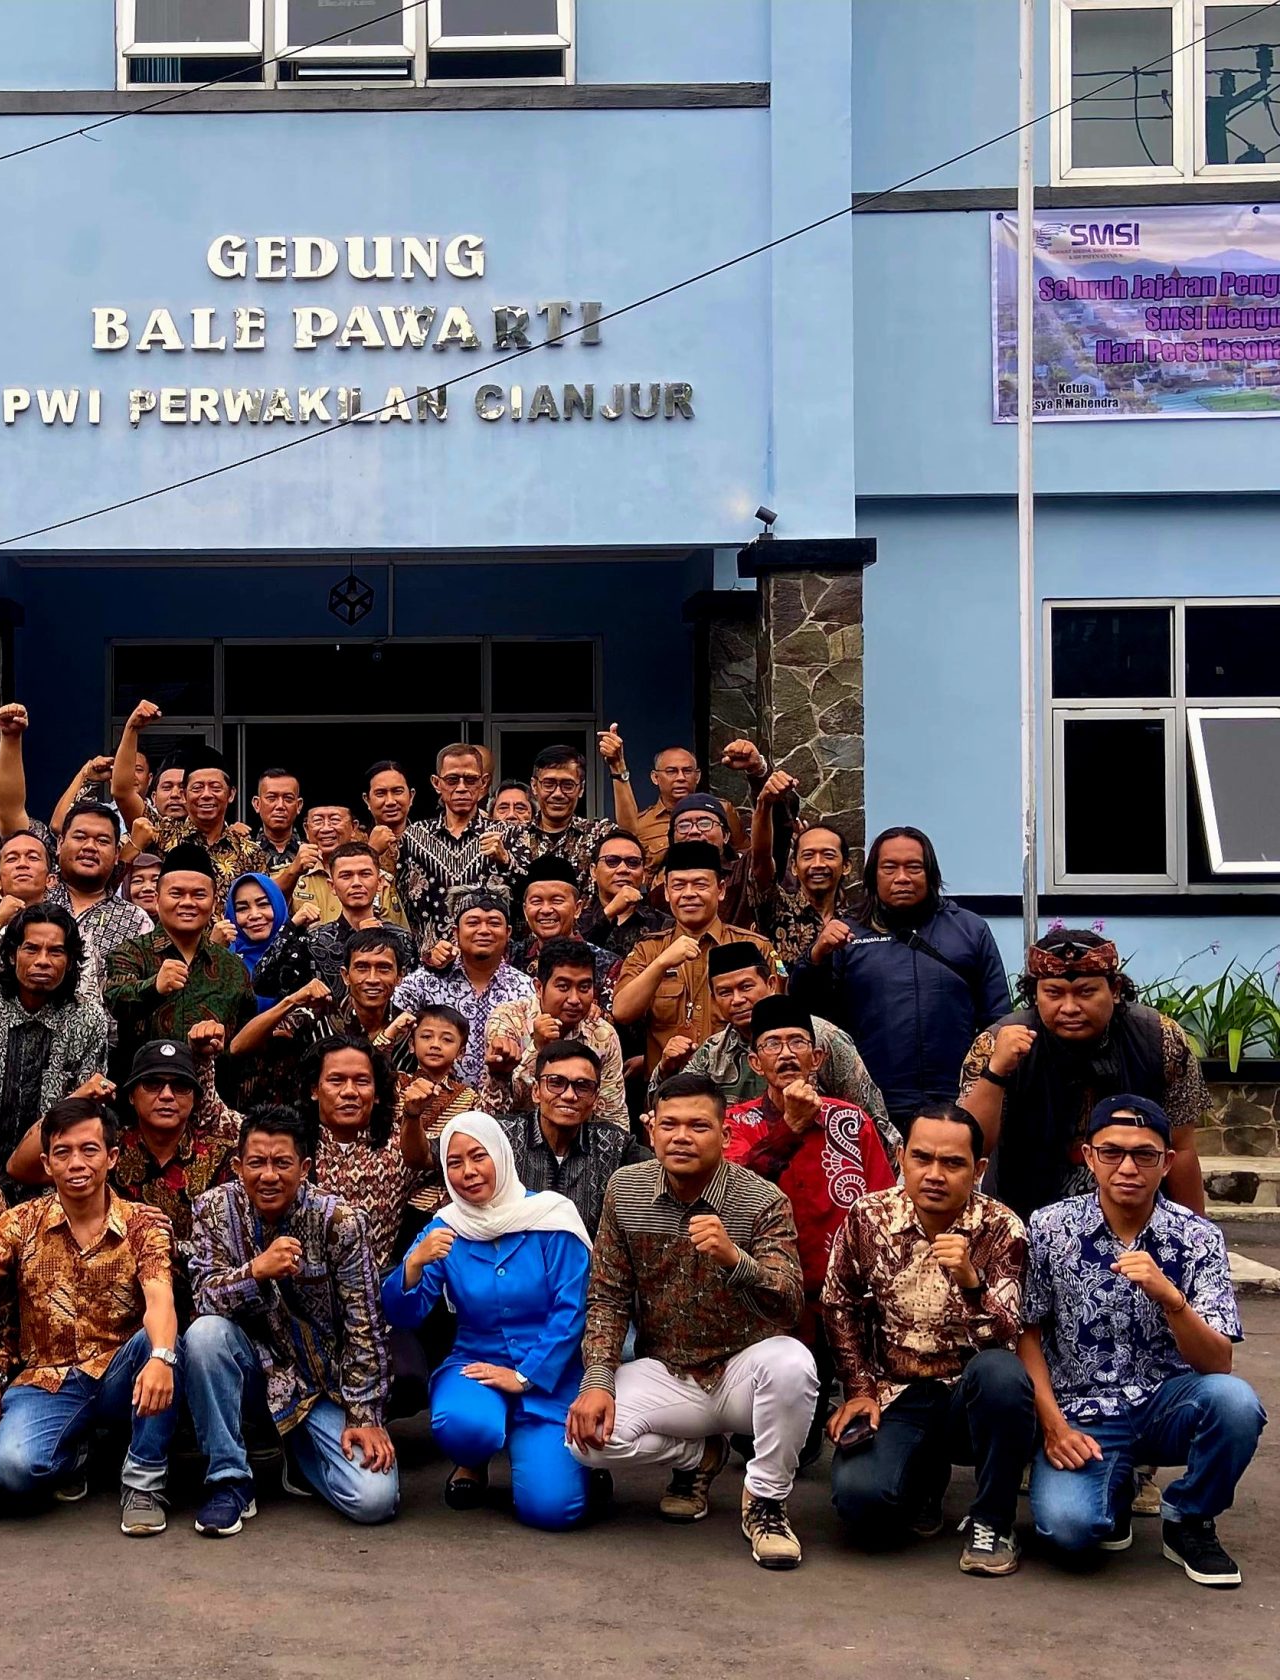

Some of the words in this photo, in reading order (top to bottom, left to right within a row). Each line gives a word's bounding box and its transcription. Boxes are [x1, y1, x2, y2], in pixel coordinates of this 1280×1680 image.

[1070, 223, 1140, 246] SMSI
[206, 234, 486, 281] GEDUNG
[1039, 275, 1128, 301] Seluruh
[1131, 274, 1217, 301] Jajaran
[1220, 272, 1280, 298] Peng
[90, 306, 266, 352] BALE
[290, 301, 604, 352] PAWARTI
[1145, 305, 1202, 331] SMSI
[1096, 339, 1144, 364] Hari
[1148, 339, 1199, 362] Pers
[1058, 383, 1090, 395] Ketua
[1, 387, 100, 425] PWI
[129, 385, 448, 427] PERWAKILAN
[473, 382, 696, 424] CIANJUR
[1032, 399, 1053, 411] sya
[1055, 399, 1063, 408] R
[1065, 398, 1119, 409] Mahendra
